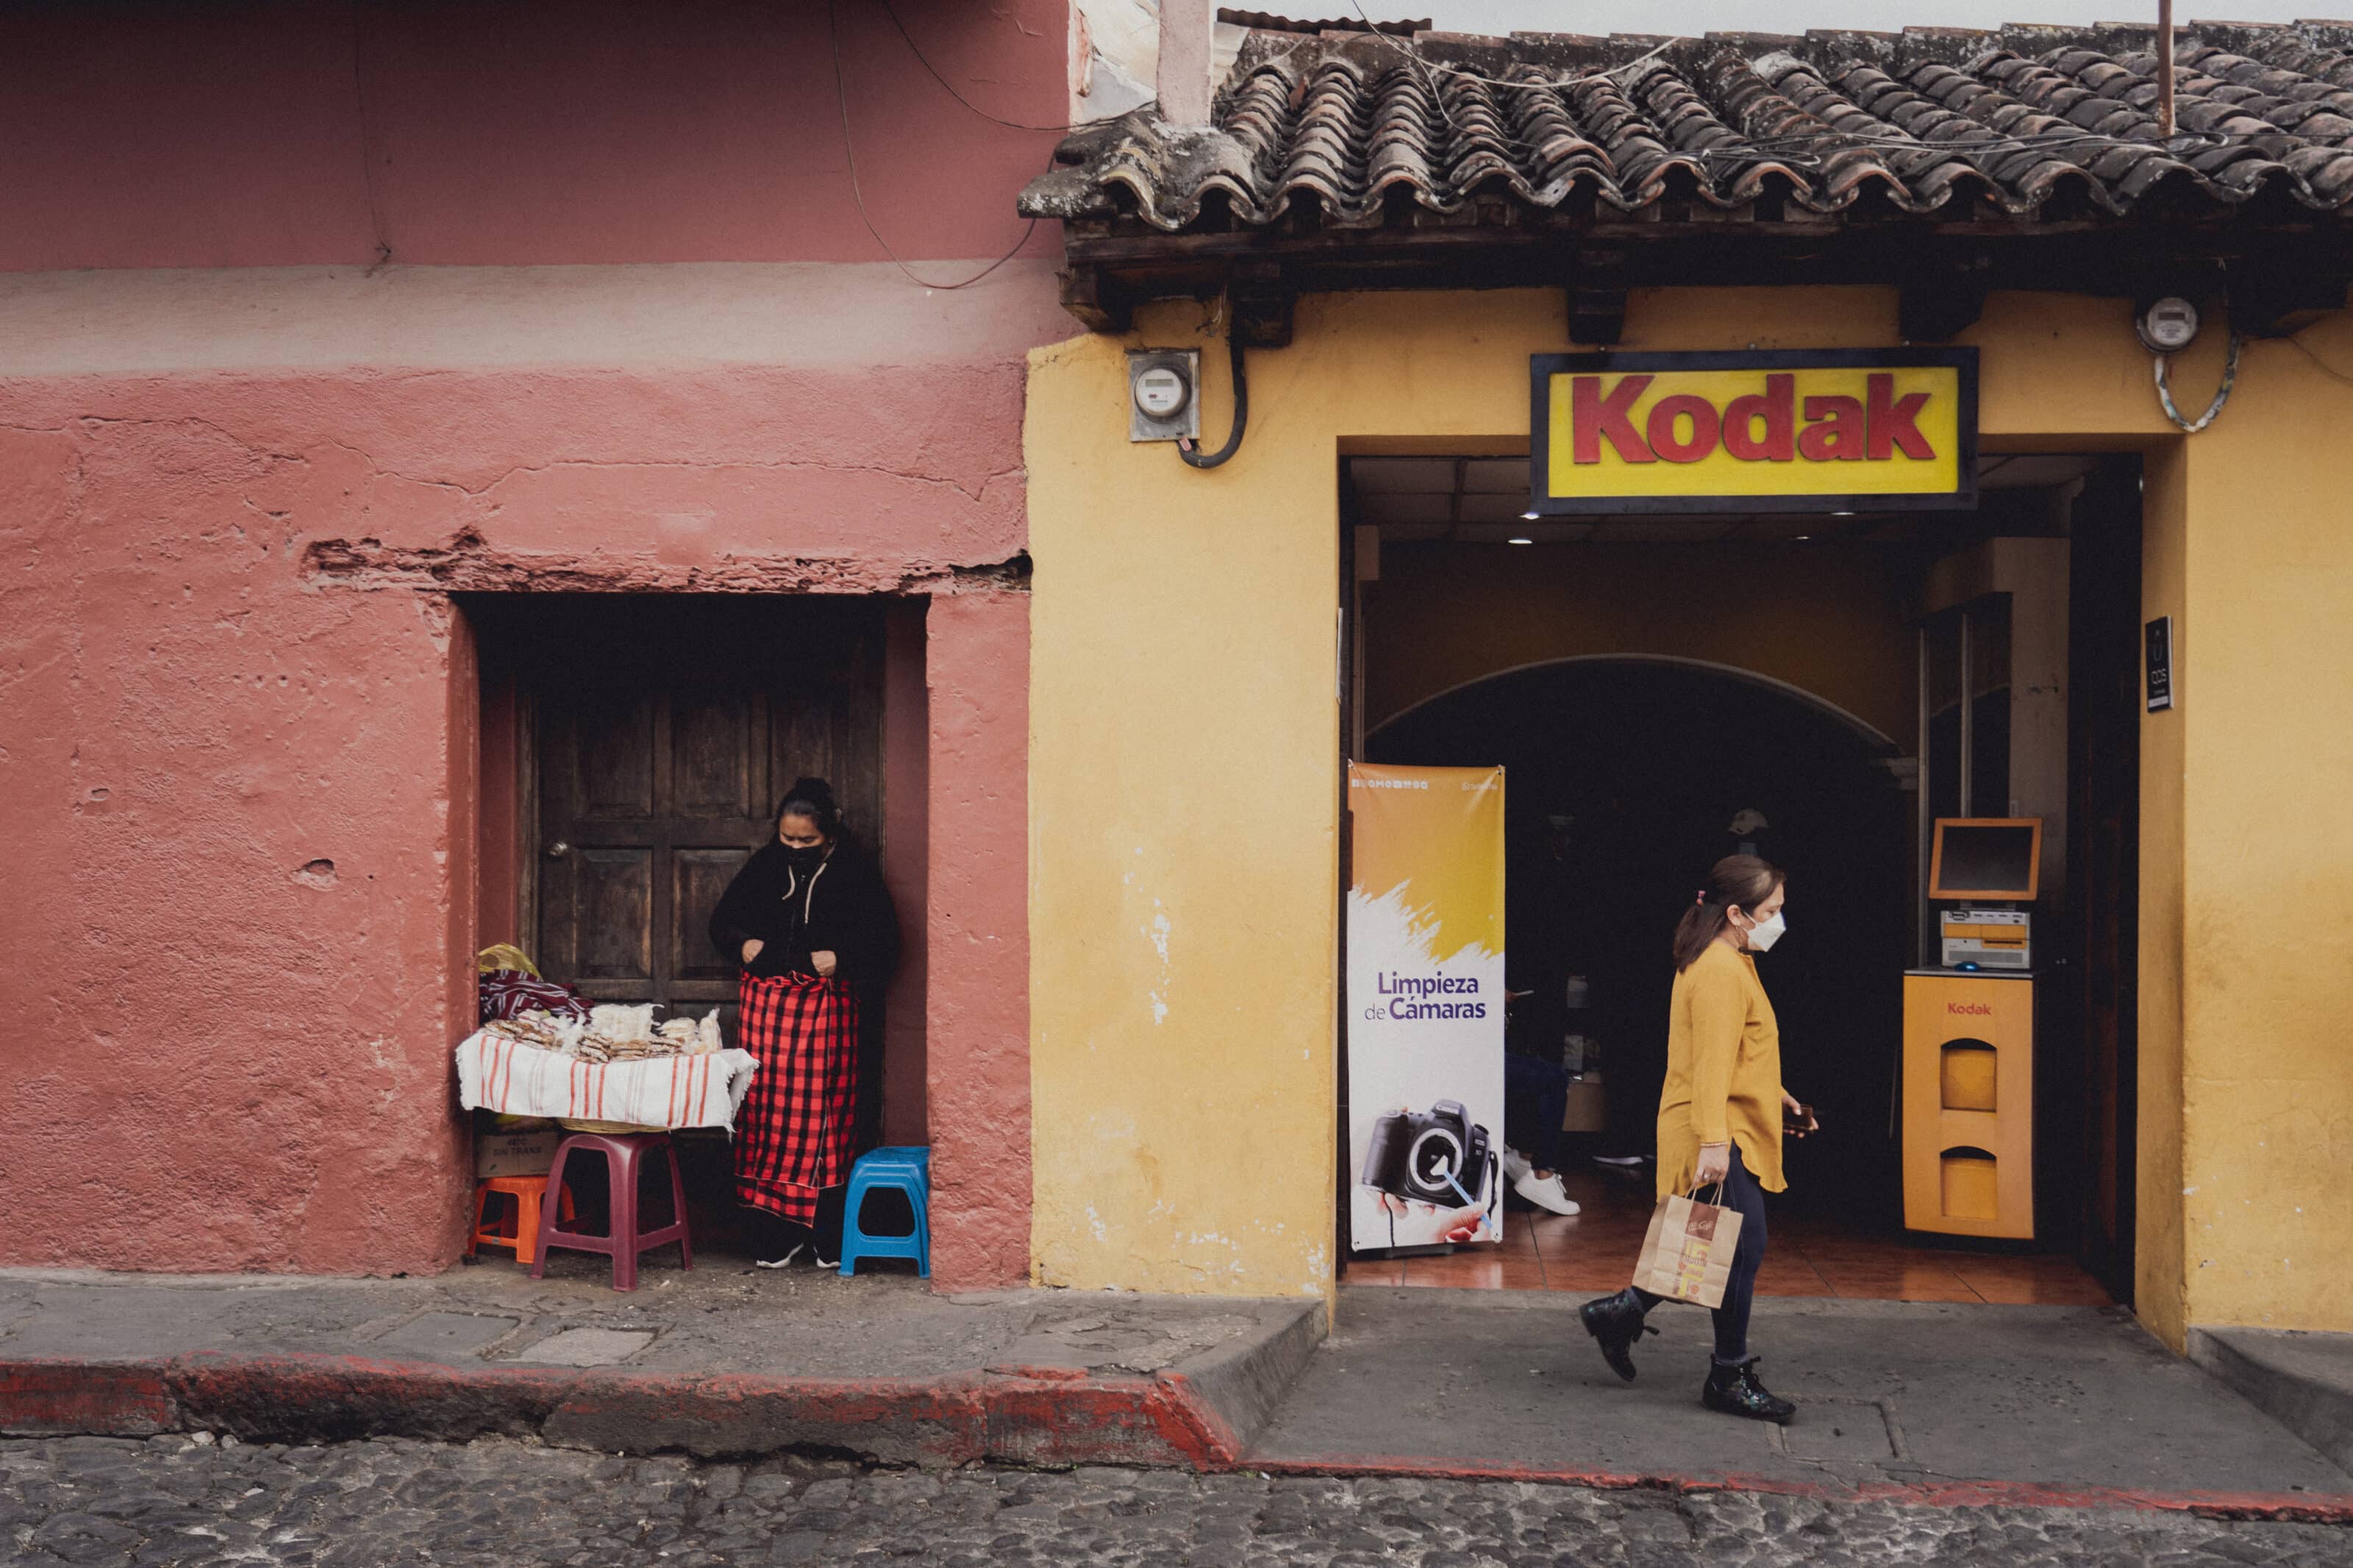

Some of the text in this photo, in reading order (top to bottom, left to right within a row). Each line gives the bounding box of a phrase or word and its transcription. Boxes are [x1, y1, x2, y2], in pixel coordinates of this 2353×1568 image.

[1572, 373, 1937, 463] Kodak
[1377, 970, 1479, 998] Limpieza
[1365, 995, 1486, 1020] de Cámaras
[1947, 1002, 1992, 1016] Kodak
